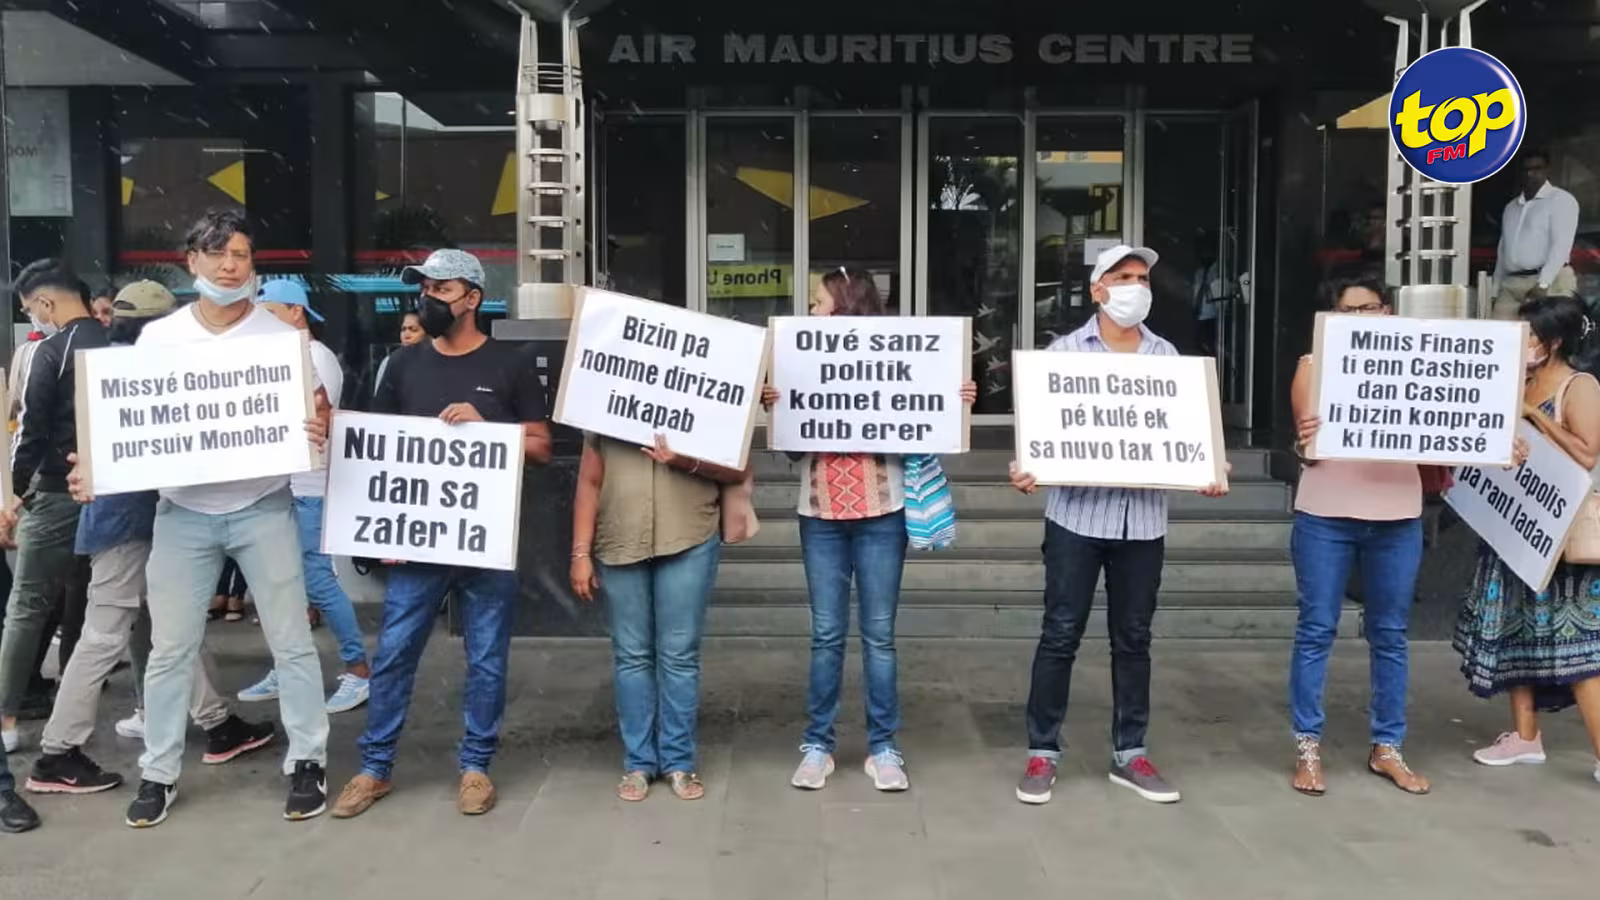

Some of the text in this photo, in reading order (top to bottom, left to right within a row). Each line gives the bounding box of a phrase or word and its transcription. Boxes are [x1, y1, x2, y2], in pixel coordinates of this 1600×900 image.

[608, 33, 1253, 64] AIR MAURITIUS CENTRE
[622, 315, 710, 359] Bizin pa
[796, 328, 940, 353] Olyé sanz
[1351, 330, 1494, 355] Minis Finans
[101, 364, 292, 399] Missyé Goburdhun
[580, 348, 745, 406] nomme dirizan
[820, 360, 912, 384] politik
[1342, 354, 1499, 380] ti enn Cashier
[1048, 372, 1177, 398] Bann Casino
[1357, 380, 1480, 404] dan Casino
[119, 393, 279, 428] Nu Met ou o défi
[607, 389, 695, 434] inkapab
[789, 389, 944, 411] komet enn
[800, 419, 932, 441] dub erer
[1061, 403, 1168, 429] pé kulé ek
[1328, 403, 1505, 430] li bizin konpran
[112, 424, 289, 463] pursuiv Monohar
[344, 427, 508, 470] Nu inosan
[1029, 439, 1205, 463] sa nuvo tax 10%
[1342, 428, 1487, 453] ki finn passé
[368, 470, 479, 510] dan sa
[1514, 459, 1567, 519] lapolis
[1479, 474, 1515, 519] rant
[1510, 503, 1553, 558] ladan
[353, 512, 487, 552] zafer la
